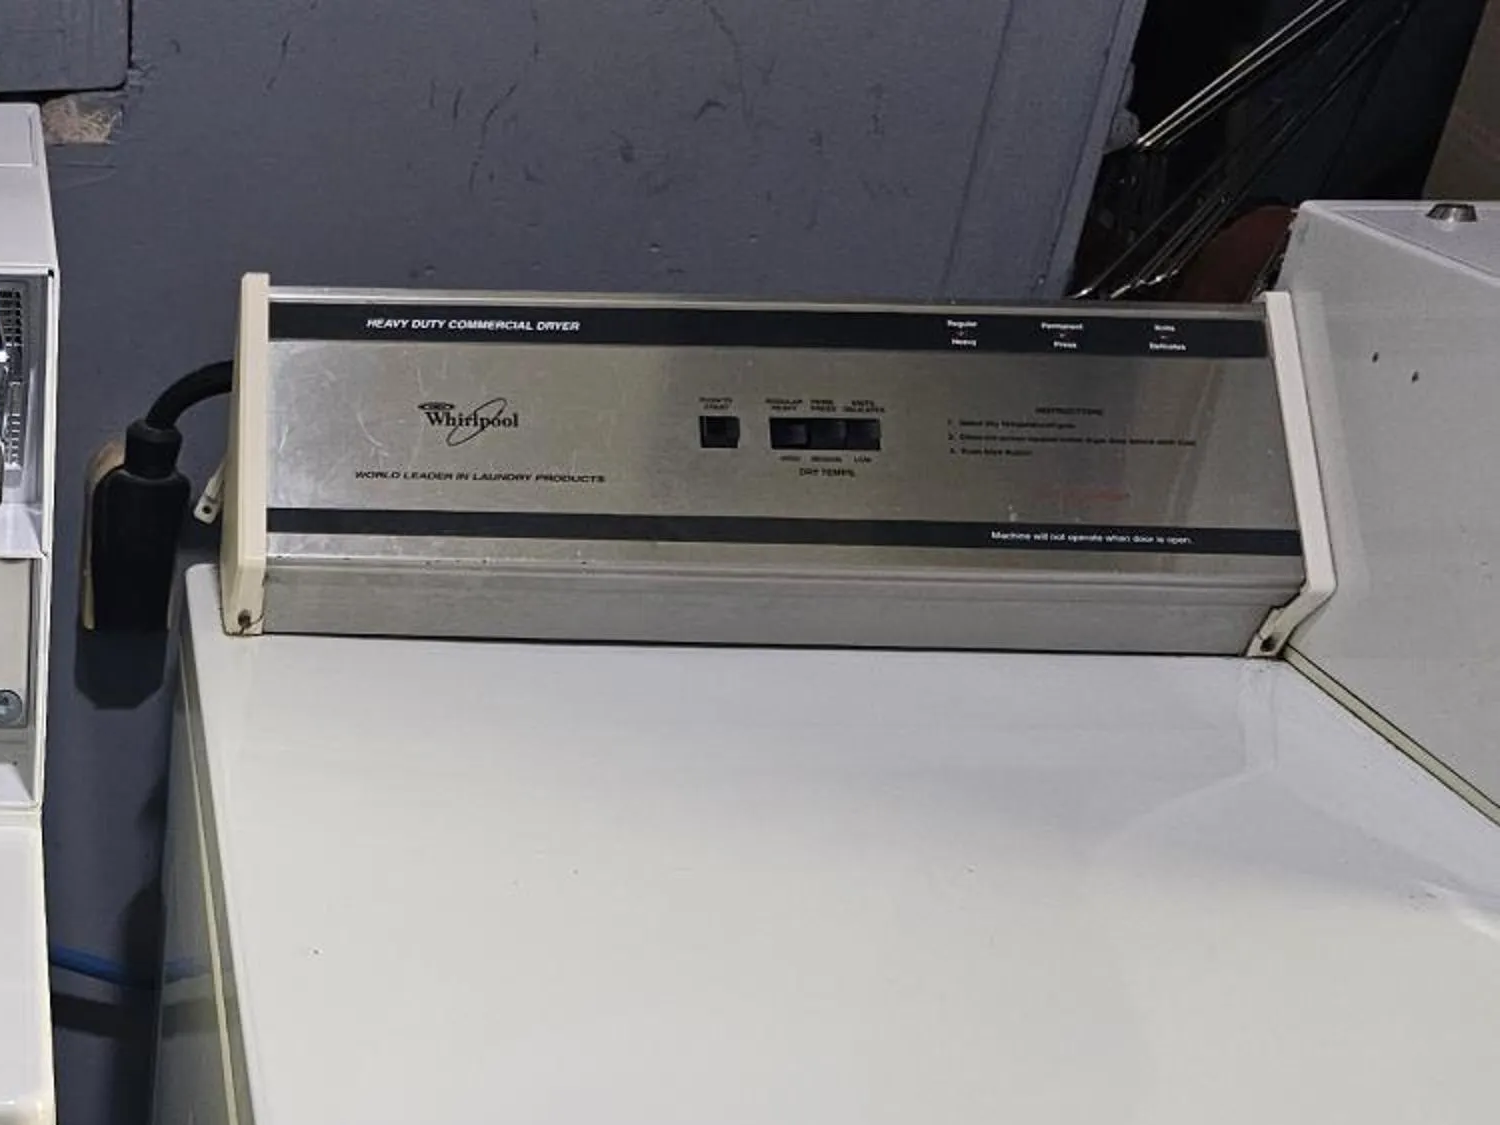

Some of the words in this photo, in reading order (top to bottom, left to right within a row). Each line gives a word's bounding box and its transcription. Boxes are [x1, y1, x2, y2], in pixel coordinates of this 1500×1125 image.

[366, 318, 409, 329] HEAVY
[411, 319, 445, 330] DUTY
[448, 319, 533, 331] COMMERCIAL
[536, 321, 581, 331] DRYER
[355, 470, 401, 481] WORLD
[403, 471, 453, 481] LEADER
[455, 472, 469, 481] IN
[472, 472, 533, 482] LAUNDRY
[535, 473, 606, 483] PRODUCTS
